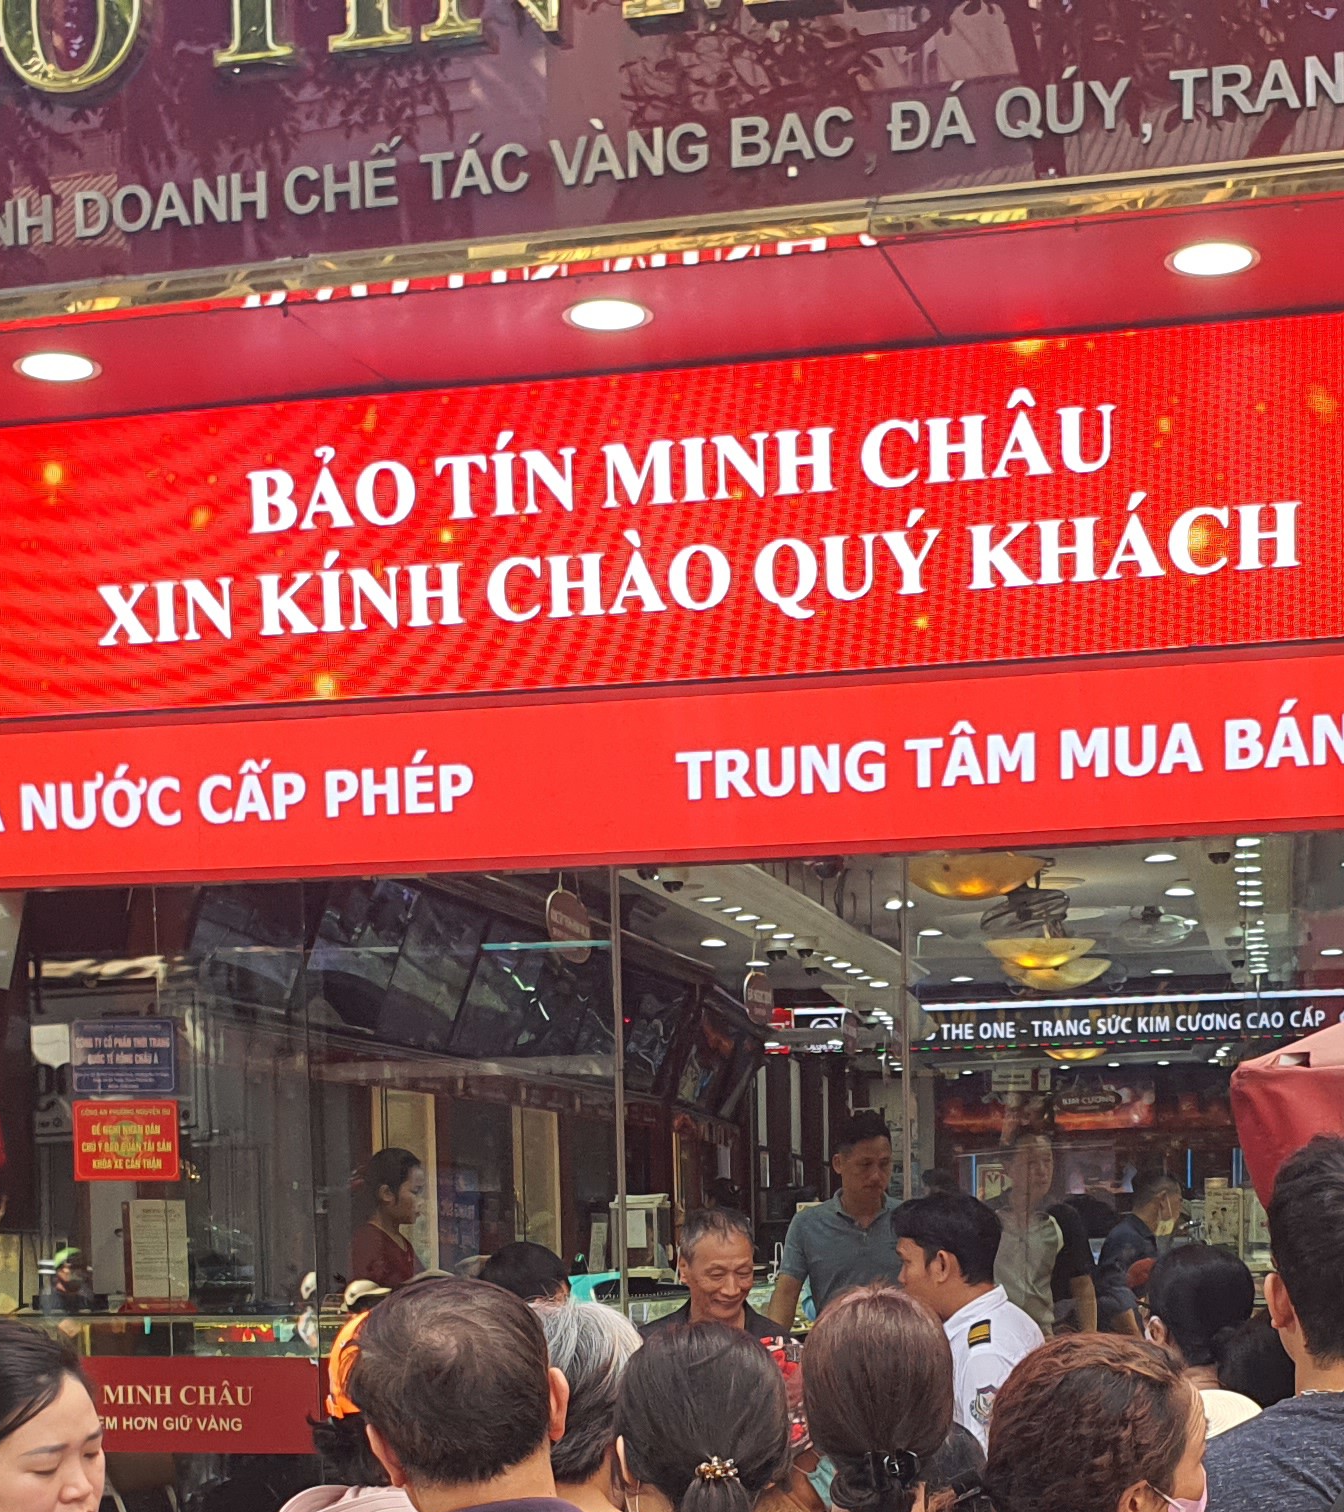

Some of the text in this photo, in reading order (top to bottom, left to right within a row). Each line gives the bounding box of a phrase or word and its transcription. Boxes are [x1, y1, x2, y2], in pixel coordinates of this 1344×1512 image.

[75, 171, 267, 237] DOANH
[283, 135, 398, 216] CHẾ
[421, 133, 530, 200] TÁC
[549, 117, 710, 188] VÀNG
[729, 106, 855, 178] BẠC
[886, 79, 976, 153] ĐÁ
[246, 387, 1116, 535] BẢO TÍN MINH CHÂU
[97, 491, 1303, 647] XIN KÍNH CHÀO QUÝ KHÁCH
[20, 763, 182, 831] NƯỚC
[198, 759, 307, 824] CẤP
[325, 750, 474, 818] PHÉP
[676, 741, 886, 800] TRUNG
[905, 721, 1037, 787] TÂM
[1060, 722, 1204, 780] MUA
[941, 1023, 974, 1041] THE
[979, 1021, 1016, 1039] ONE
[1032, 1018, 1092, 1038] TRANG
[1096, 1013, 1133, 1035] SỨC
[1137, 1014, 1171, 1034] KIM
[1175, 1011, 1242, 1032] CƯƠNG
[1246, 1010, 1285, 1029] CAO
[1289, 1005, 1327, 1028] CẤP
[103, 1379, 254, 1406] MINH CHÂU
[122, 1416, 158, 1430] HƠN
[163, 1414, 193, 1431] GIỮ
[196, 1414, 243, 1431] VÀNG
